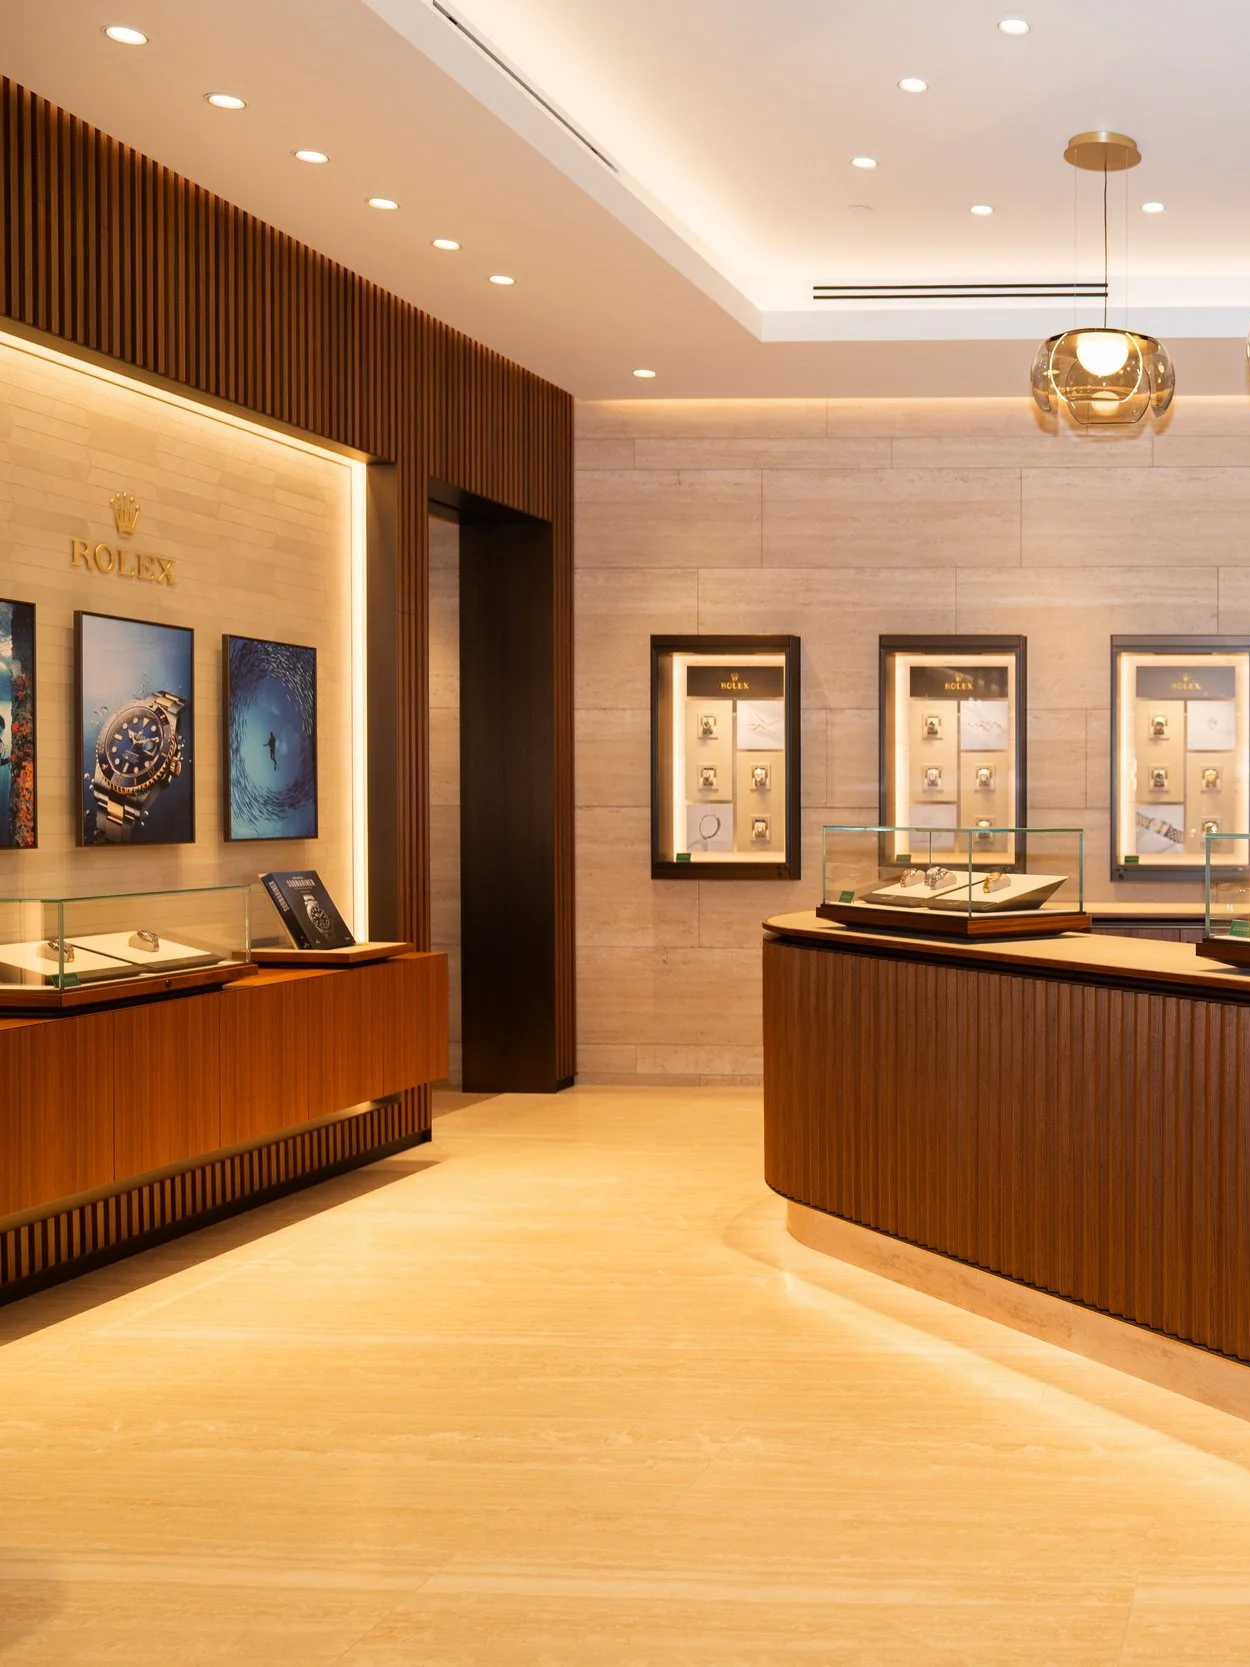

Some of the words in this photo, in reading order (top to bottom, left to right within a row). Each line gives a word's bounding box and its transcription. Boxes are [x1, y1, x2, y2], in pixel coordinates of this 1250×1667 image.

[71, 539, 176, 586] ROLEX
[720, 682, 750, 690] ROLEX
[944, 682, 974, 690] ROLEX
[1171, 682, 1201, 690] ROLEX
